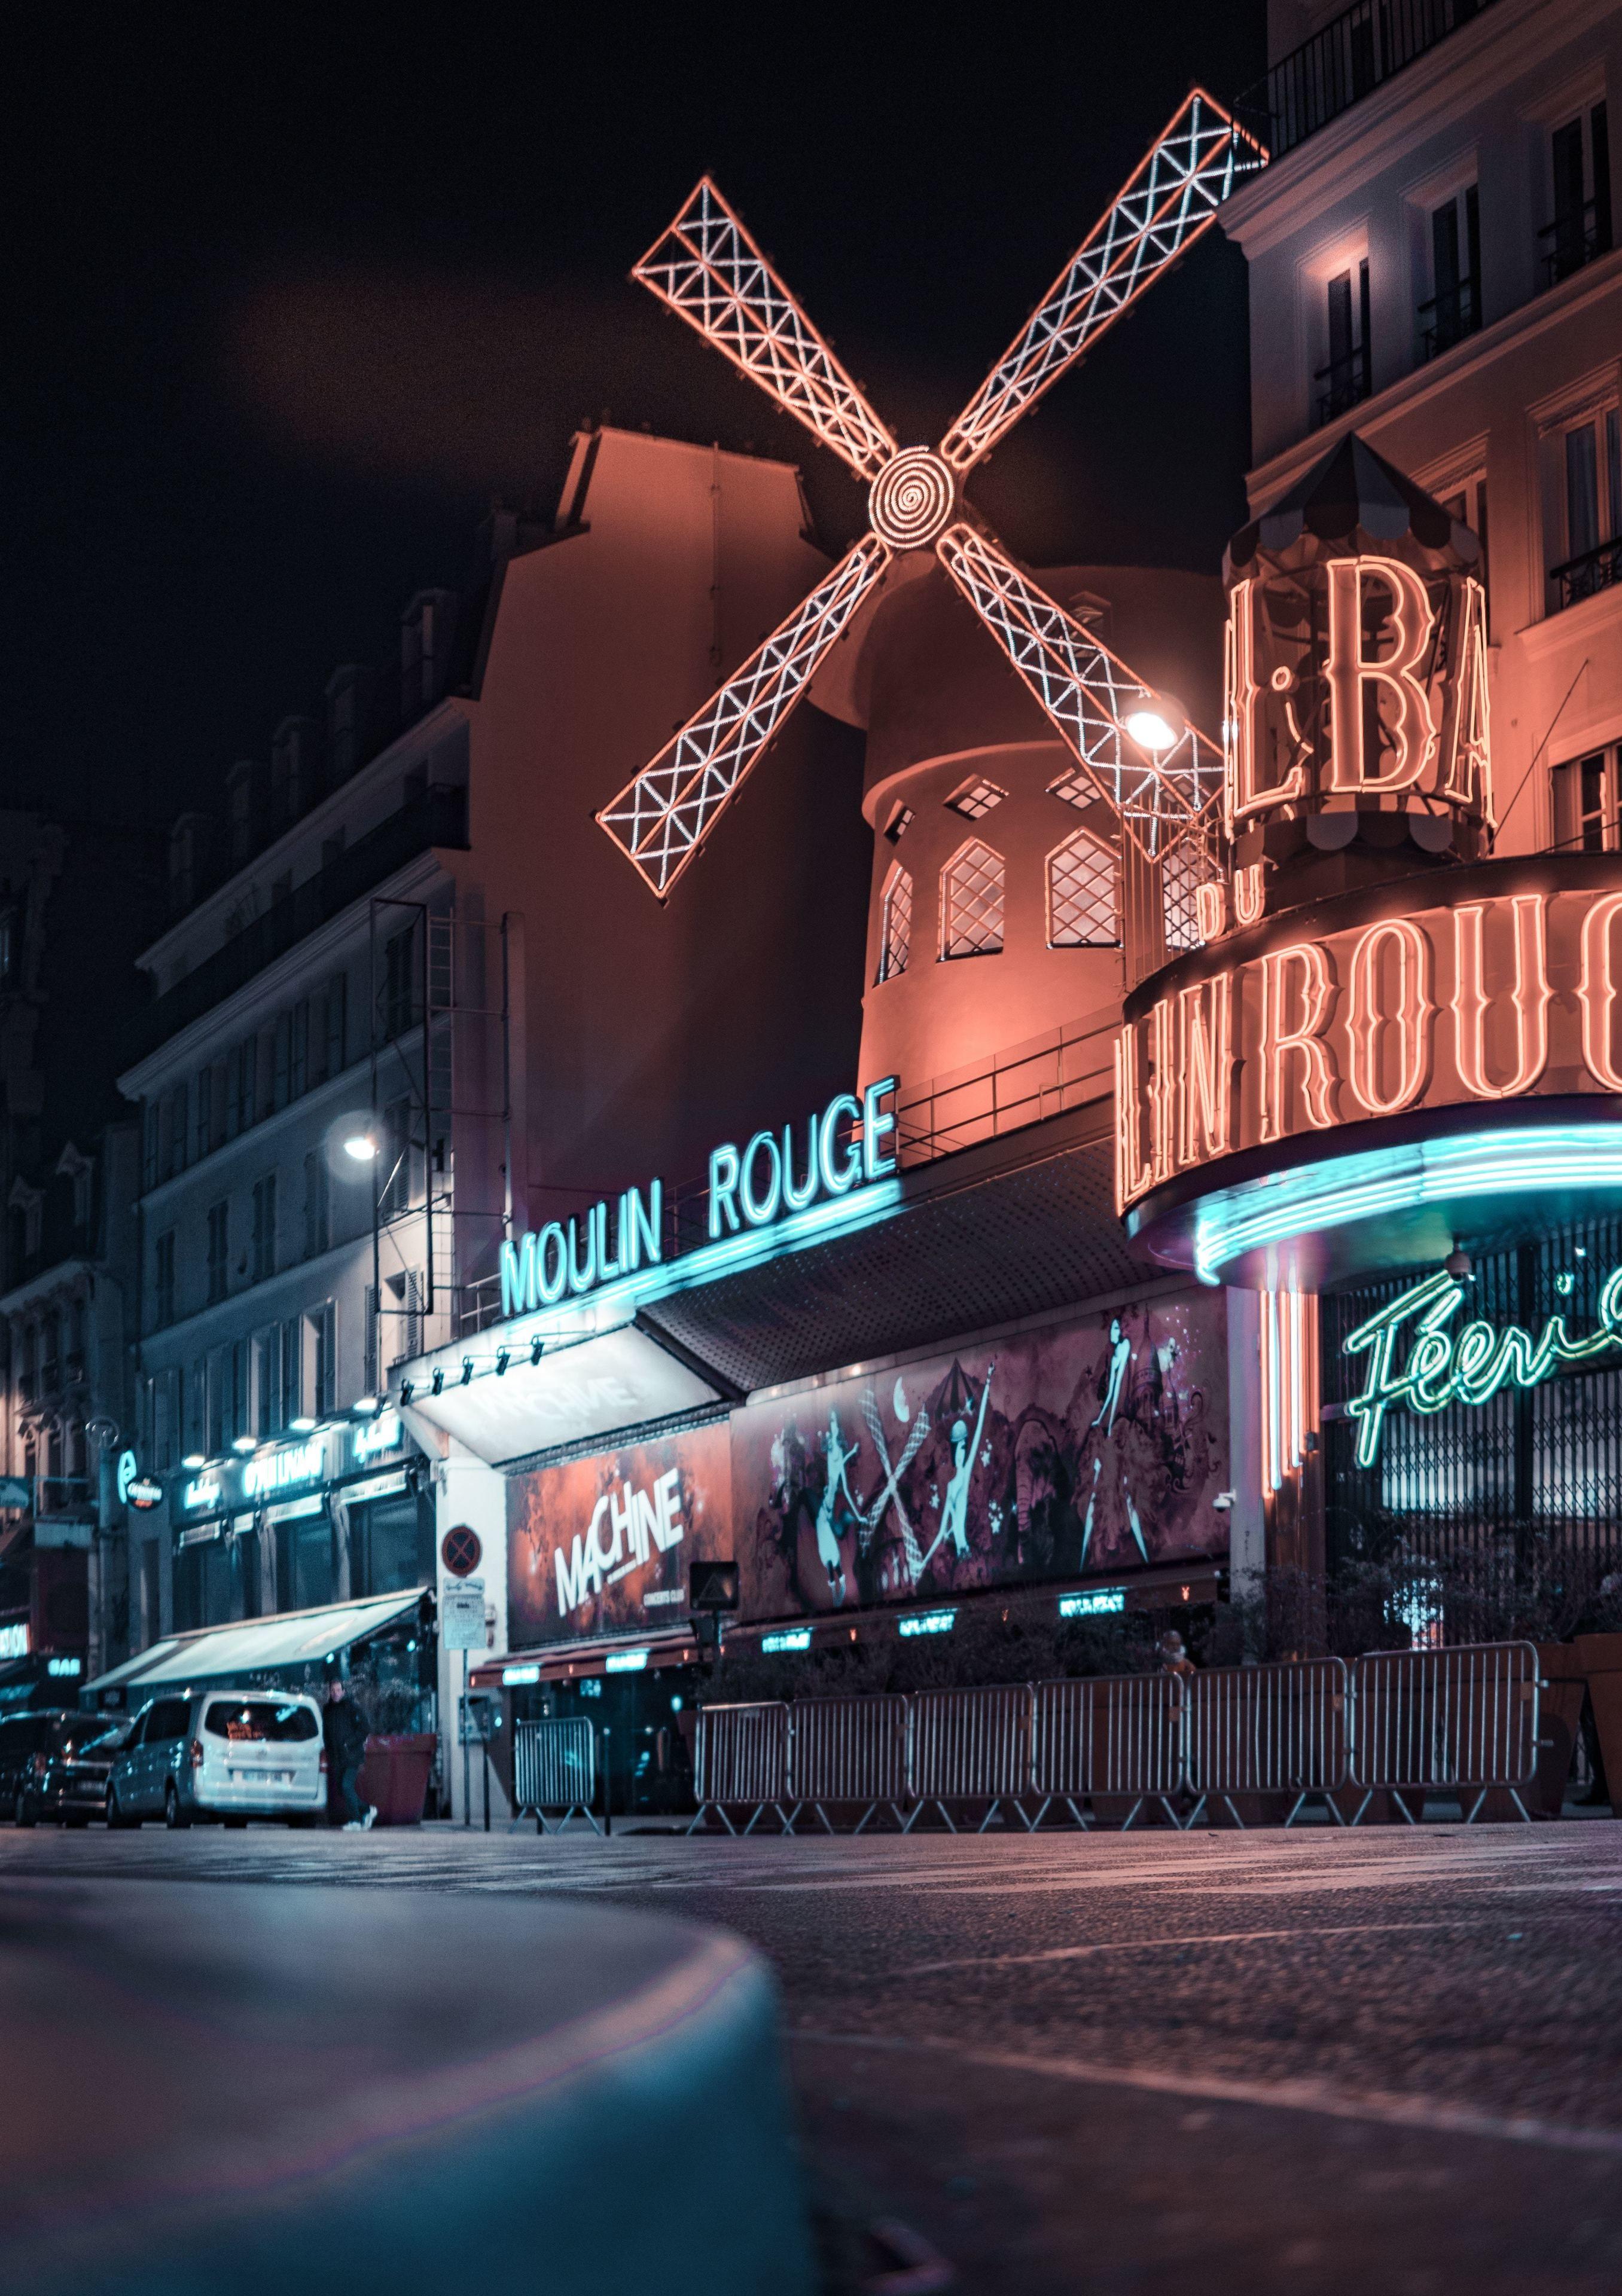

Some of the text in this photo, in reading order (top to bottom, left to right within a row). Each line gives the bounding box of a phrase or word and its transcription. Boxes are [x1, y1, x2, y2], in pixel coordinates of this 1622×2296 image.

[1196, 864, 1266, 941] DU
[1115, 972, 1233, 1217] LIN
[501, 1074, 901, 1315] MOULIN ROUGE
[554, 1467, 684, 1618] MACHINE
